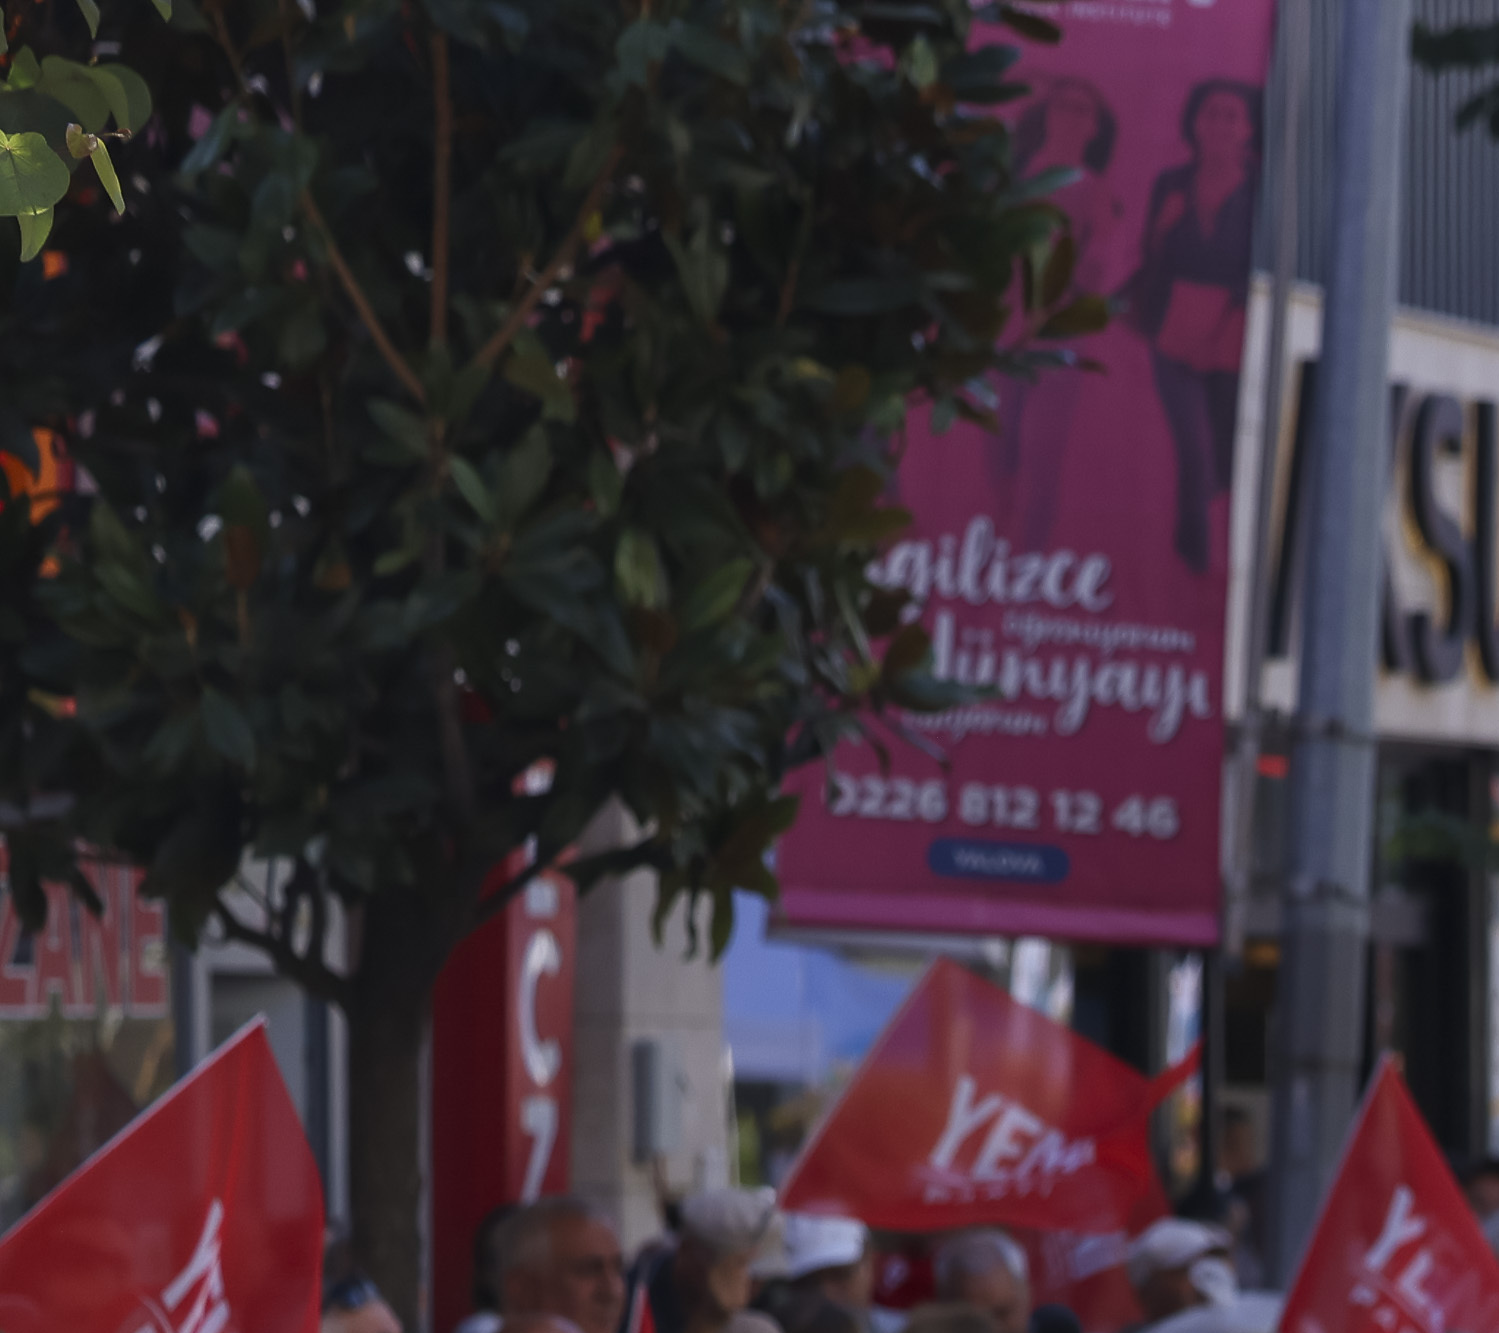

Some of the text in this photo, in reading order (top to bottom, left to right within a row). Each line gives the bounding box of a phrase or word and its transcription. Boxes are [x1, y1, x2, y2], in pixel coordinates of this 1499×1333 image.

[864, 514, 1117, 622] gilizce
[822, 773, 1181, 840] 0226 812 12 46
